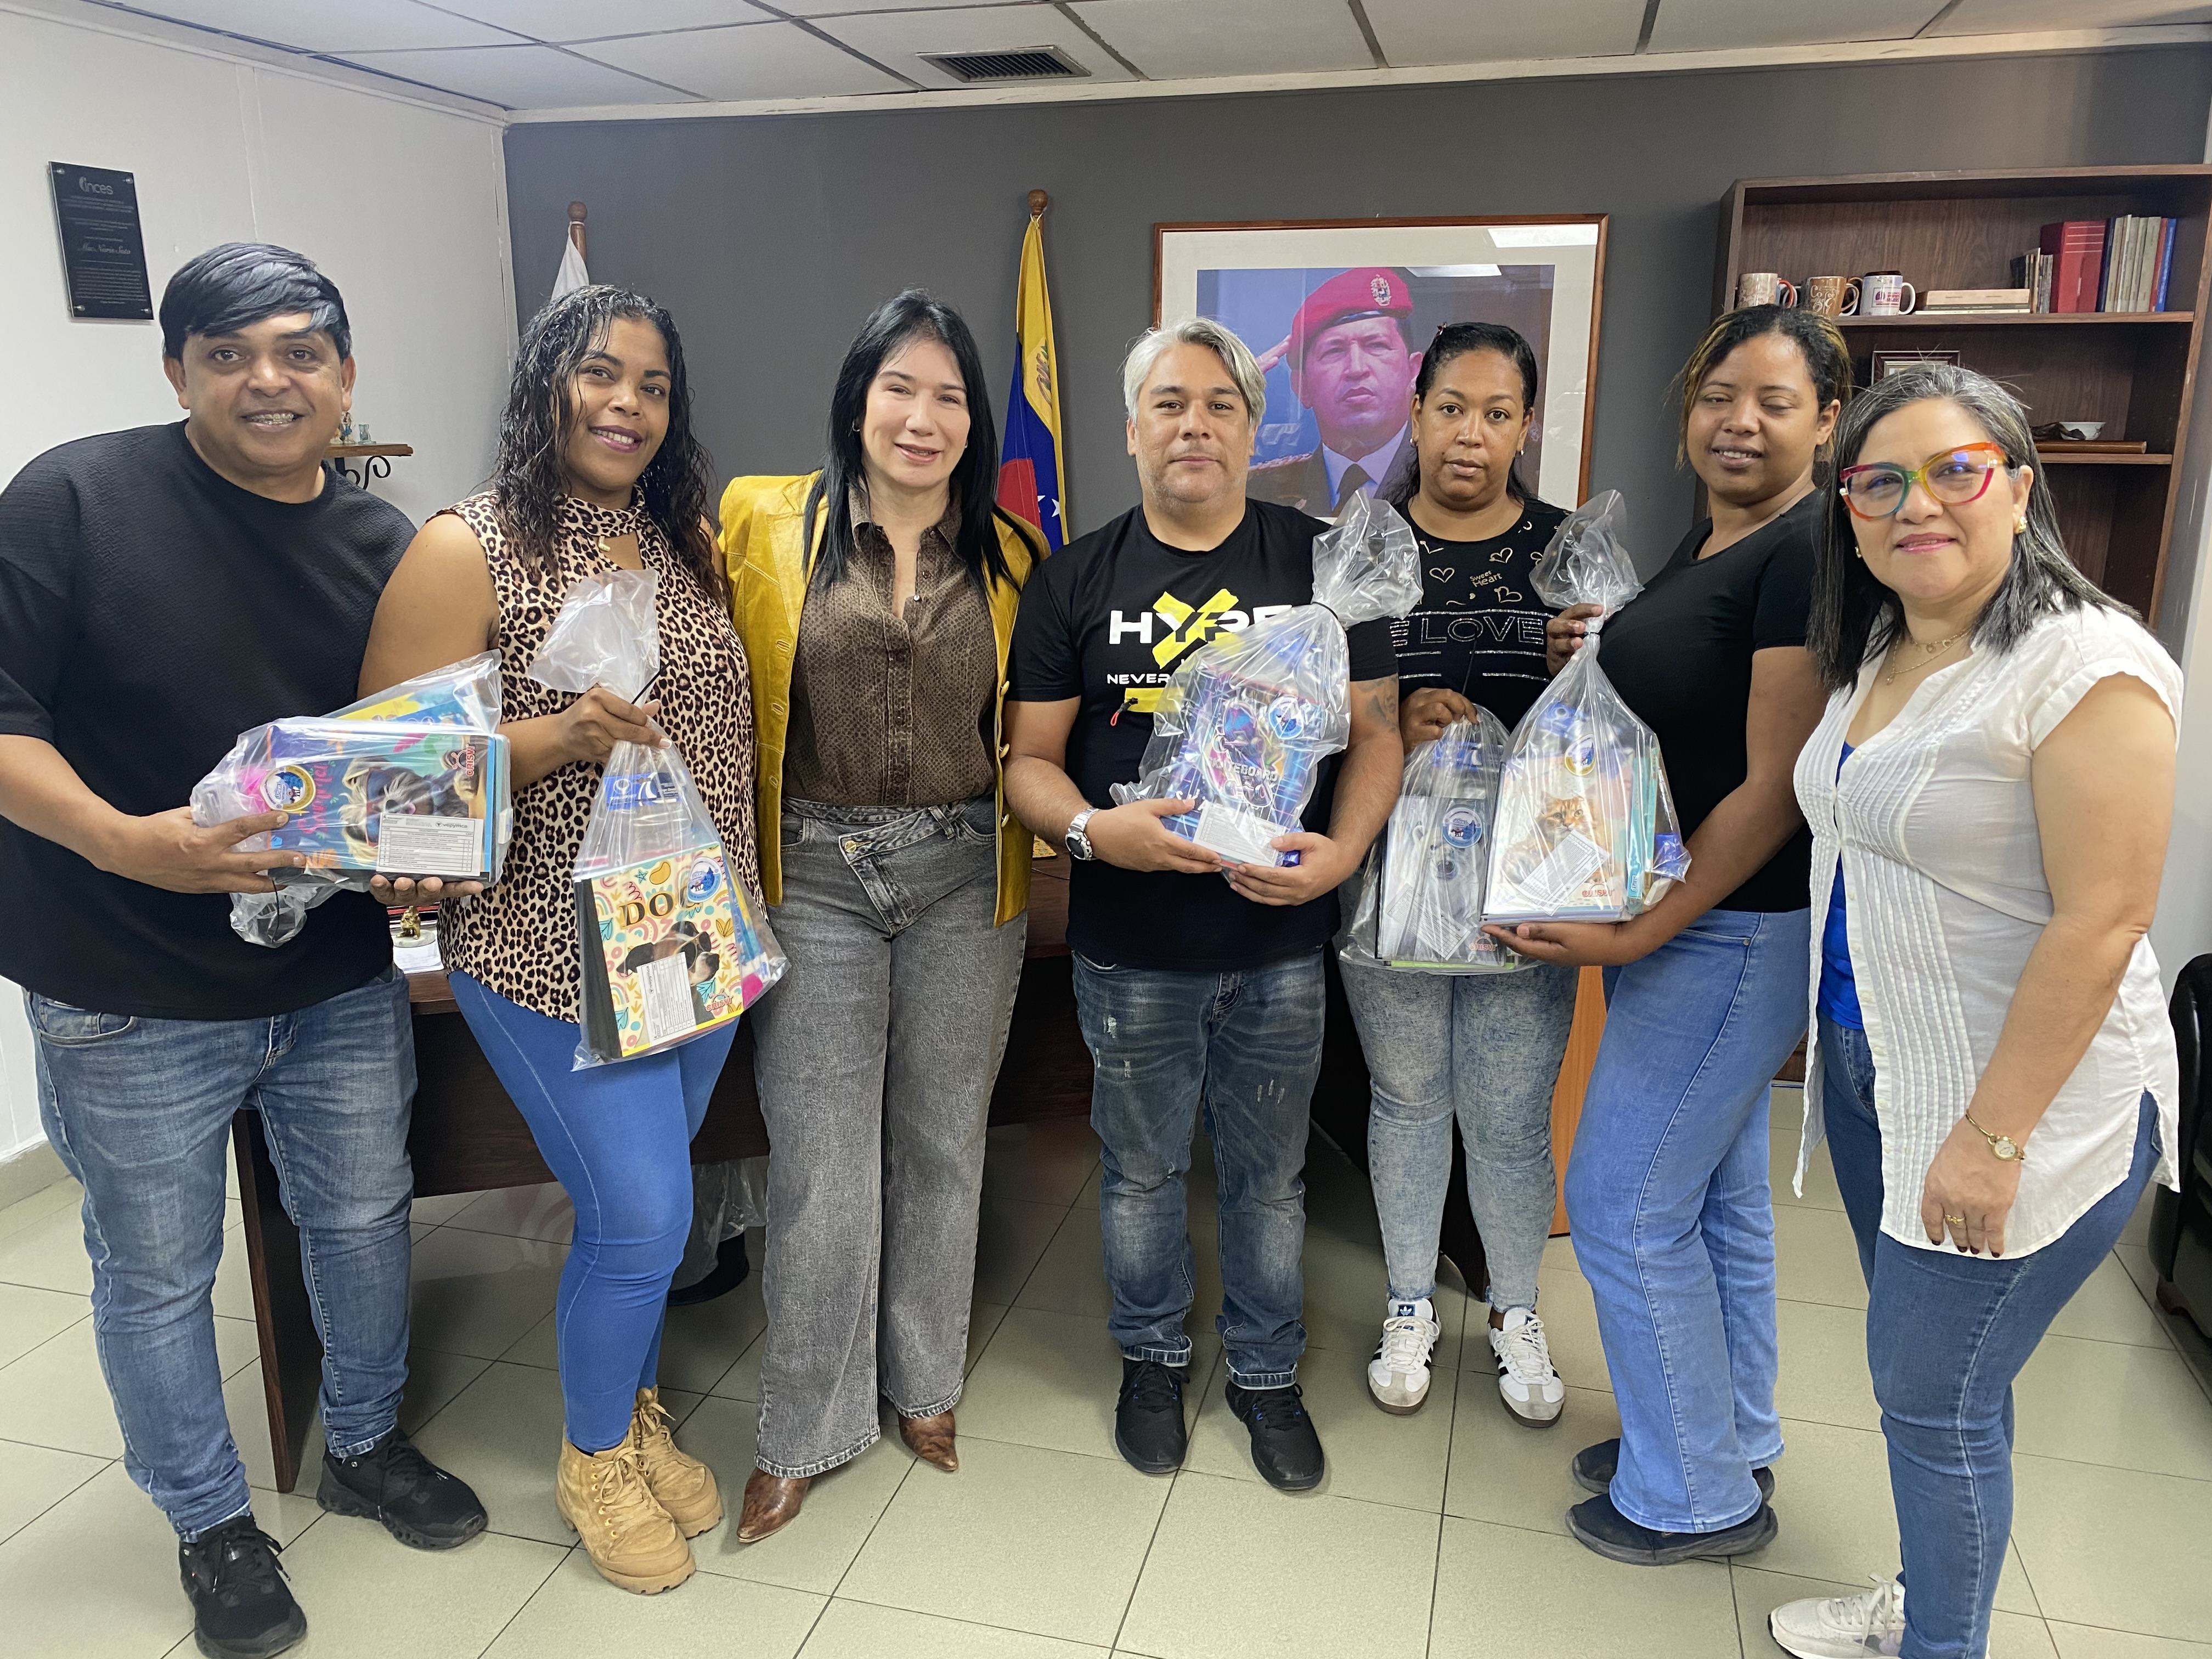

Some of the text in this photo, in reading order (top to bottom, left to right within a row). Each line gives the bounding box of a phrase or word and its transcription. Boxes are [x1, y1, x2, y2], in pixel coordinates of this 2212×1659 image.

[1470, 571, 1492, 582] Sweet
[1472, 573, 1503, 587] Heart
[1420, 616, 1544, 645] LOVE
[1107, 673, 1172, 685] NEVER
[705, 996, 732, 1012] CRISVI
